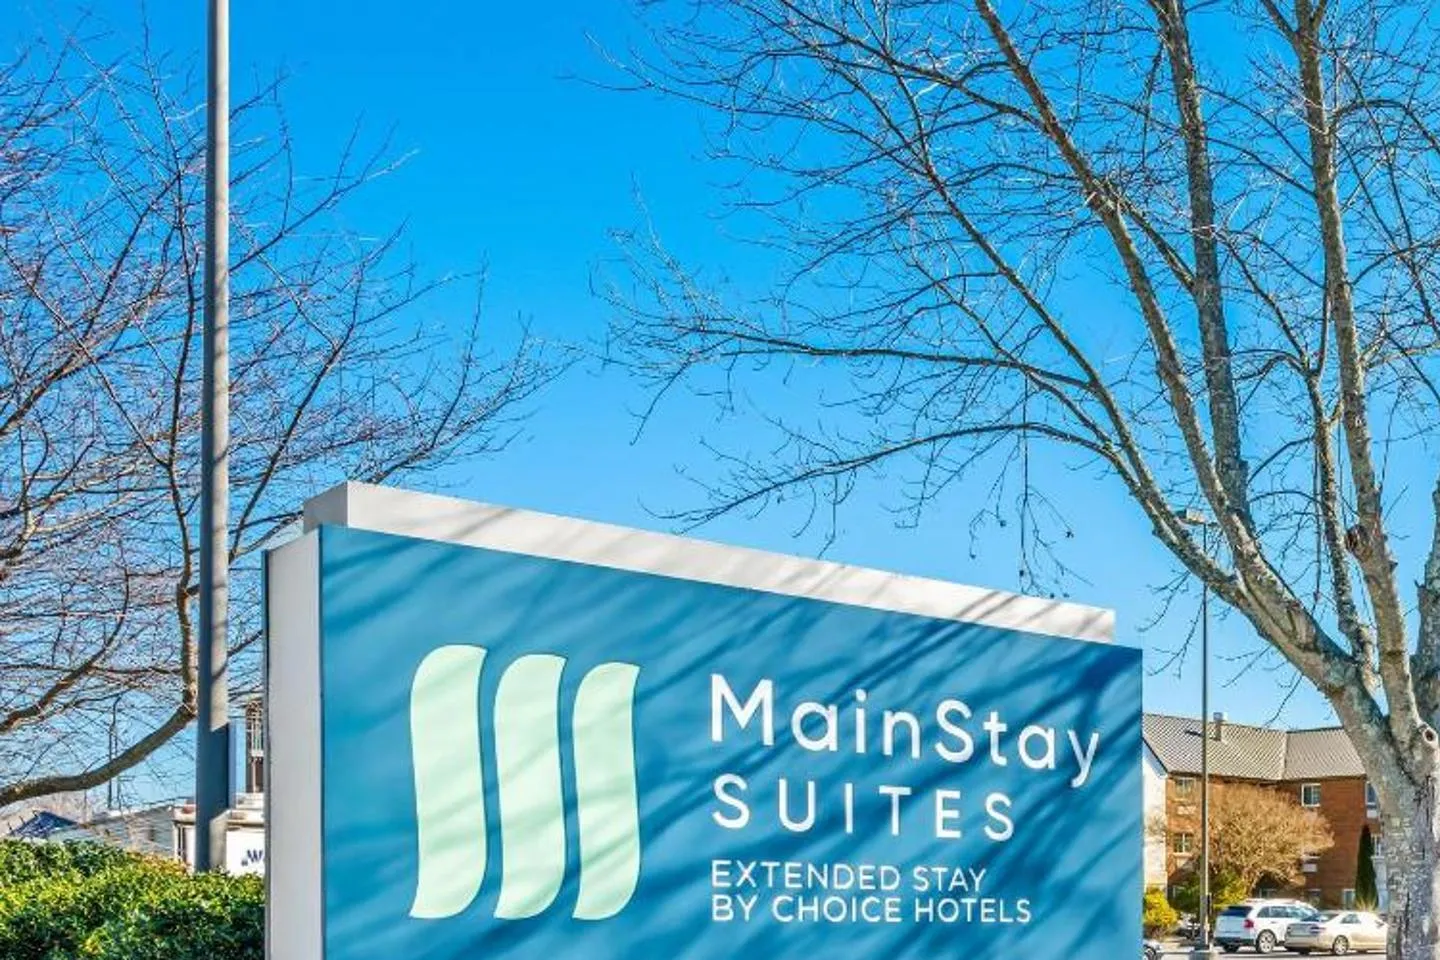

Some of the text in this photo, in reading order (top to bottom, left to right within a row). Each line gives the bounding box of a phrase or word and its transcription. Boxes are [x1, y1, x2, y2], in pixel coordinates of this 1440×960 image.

[710, 673, 1100, 788] MainStay
[711, 773, 1014, 841] SUITES
[710, 860, 986, 892] EXTENDED STAY
[710, 893, 1031, 924] BY CHOICE HOTELS
